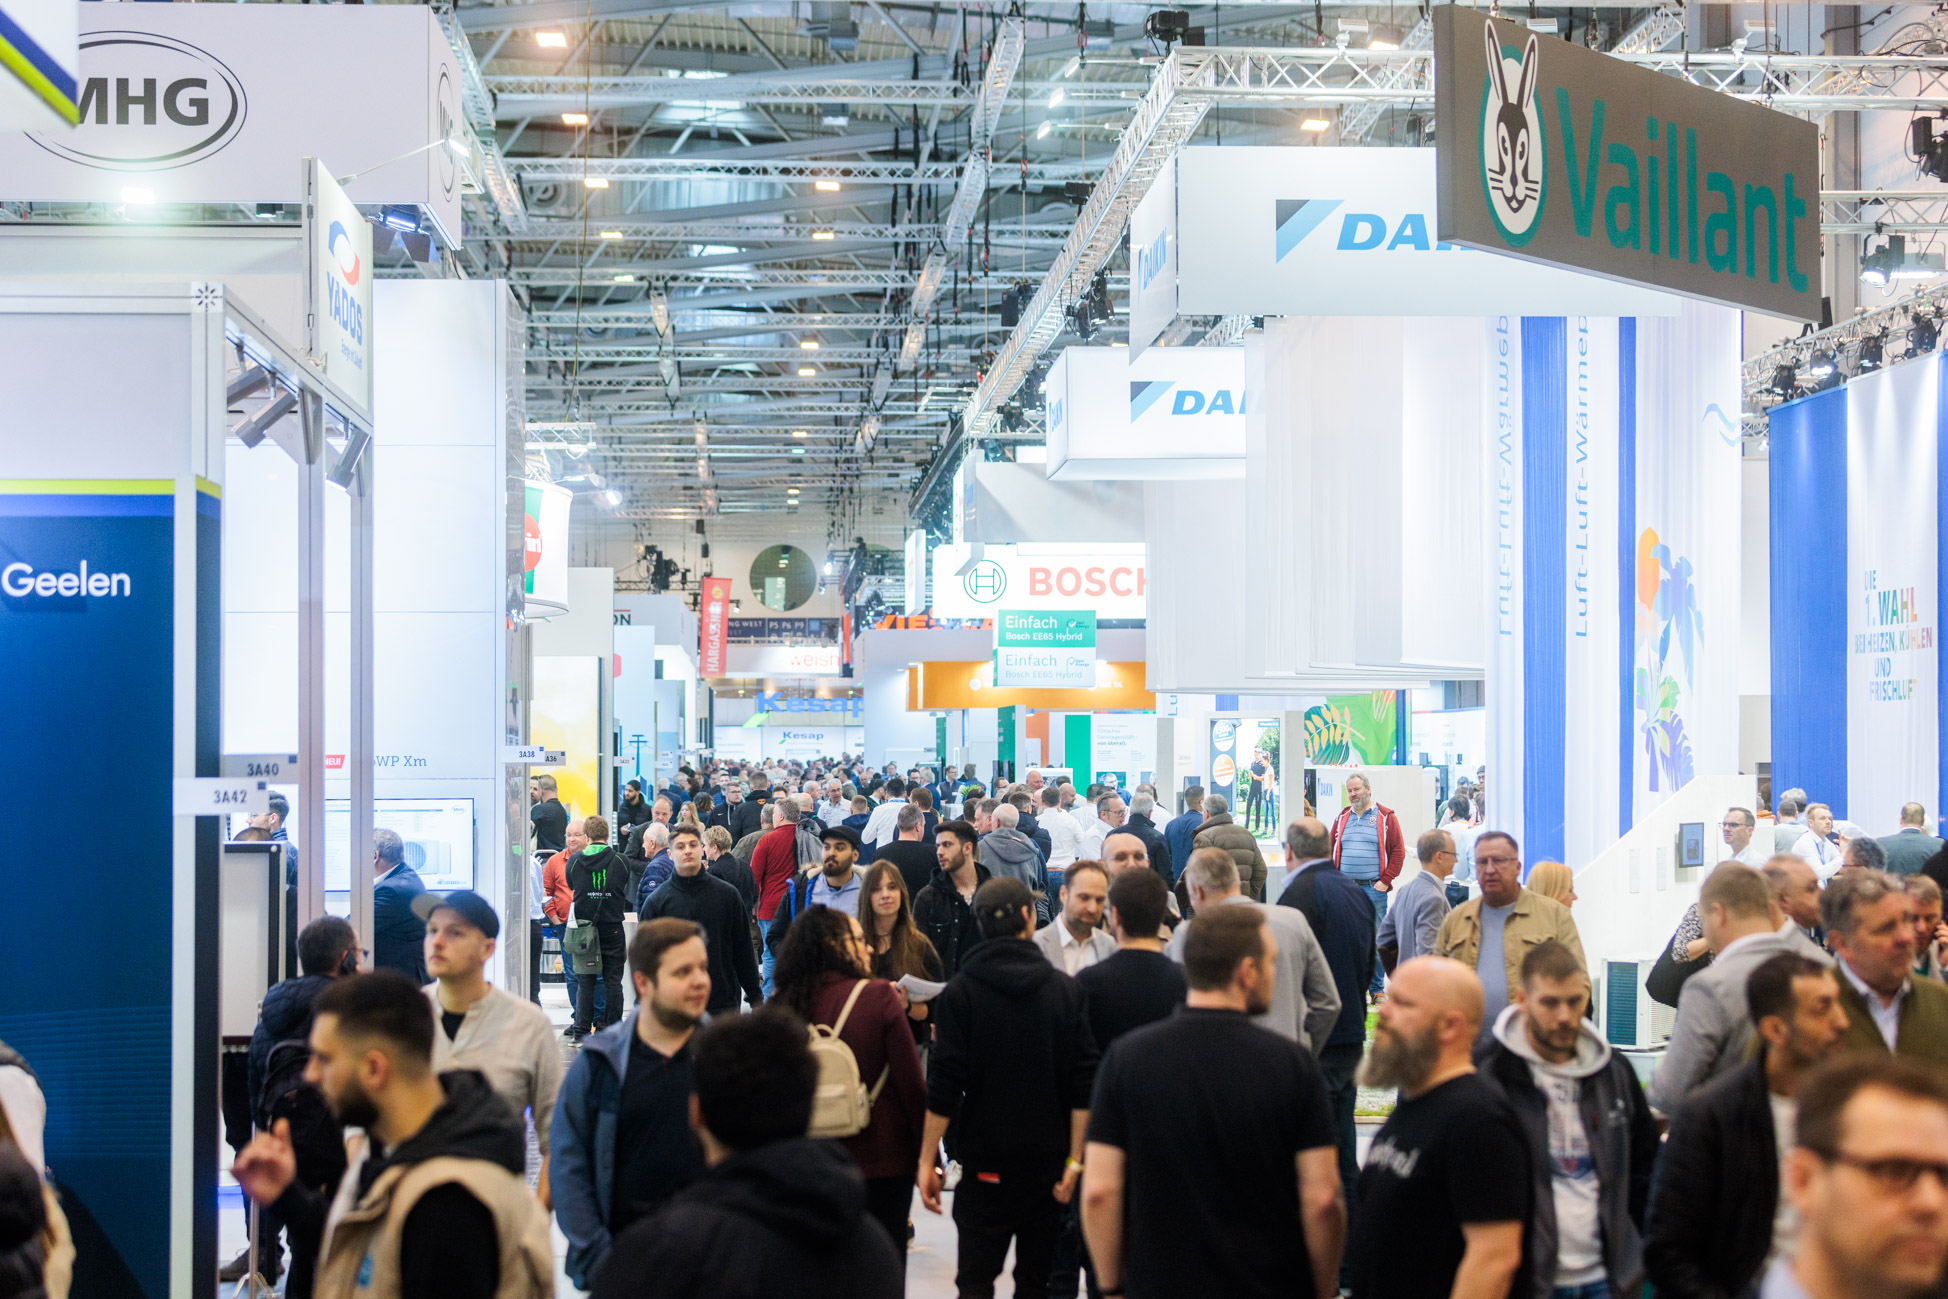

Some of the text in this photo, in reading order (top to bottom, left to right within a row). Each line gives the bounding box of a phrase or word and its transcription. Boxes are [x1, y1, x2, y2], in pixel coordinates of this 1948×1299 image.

[79, 78, 209, 126] MHG
[1555, 87, 1808, 293] Vaillant
[1337, 213, 1476, 251] DA
[1143, 226, 1167, 291] DAIKIN
[327, 271, 363, 347] YADOS
[1, 559, 131, 597] Geelen
[1865, 570, 1876, 591] DIE
[1878, 587, 1917, 626] WAHL
[769, 621, 804, 629] P5 P6 P9
[1005, 615, 1058, 629] Einfach
[1006, 632, 1030, 641] Bosch
[1056, 630, 1082, 642] Hybrid
[1900, 625, 1932, 651] KÜHLEN
[1005, 654, 1057, 667] Einfach
[1875, 657, 1891, 677] UND
[1006, 670, 1030, 679] Bosch
[1056, 669, 1082, 680] Hybrid
[757, 692, 864, 718] Kesap
[783, 731, 824, 741] Kesap
[247, 763, 279, 776] 3A40
[403, 755, 427, 767] Xm
[213, 790, 248, 804] 3A42
